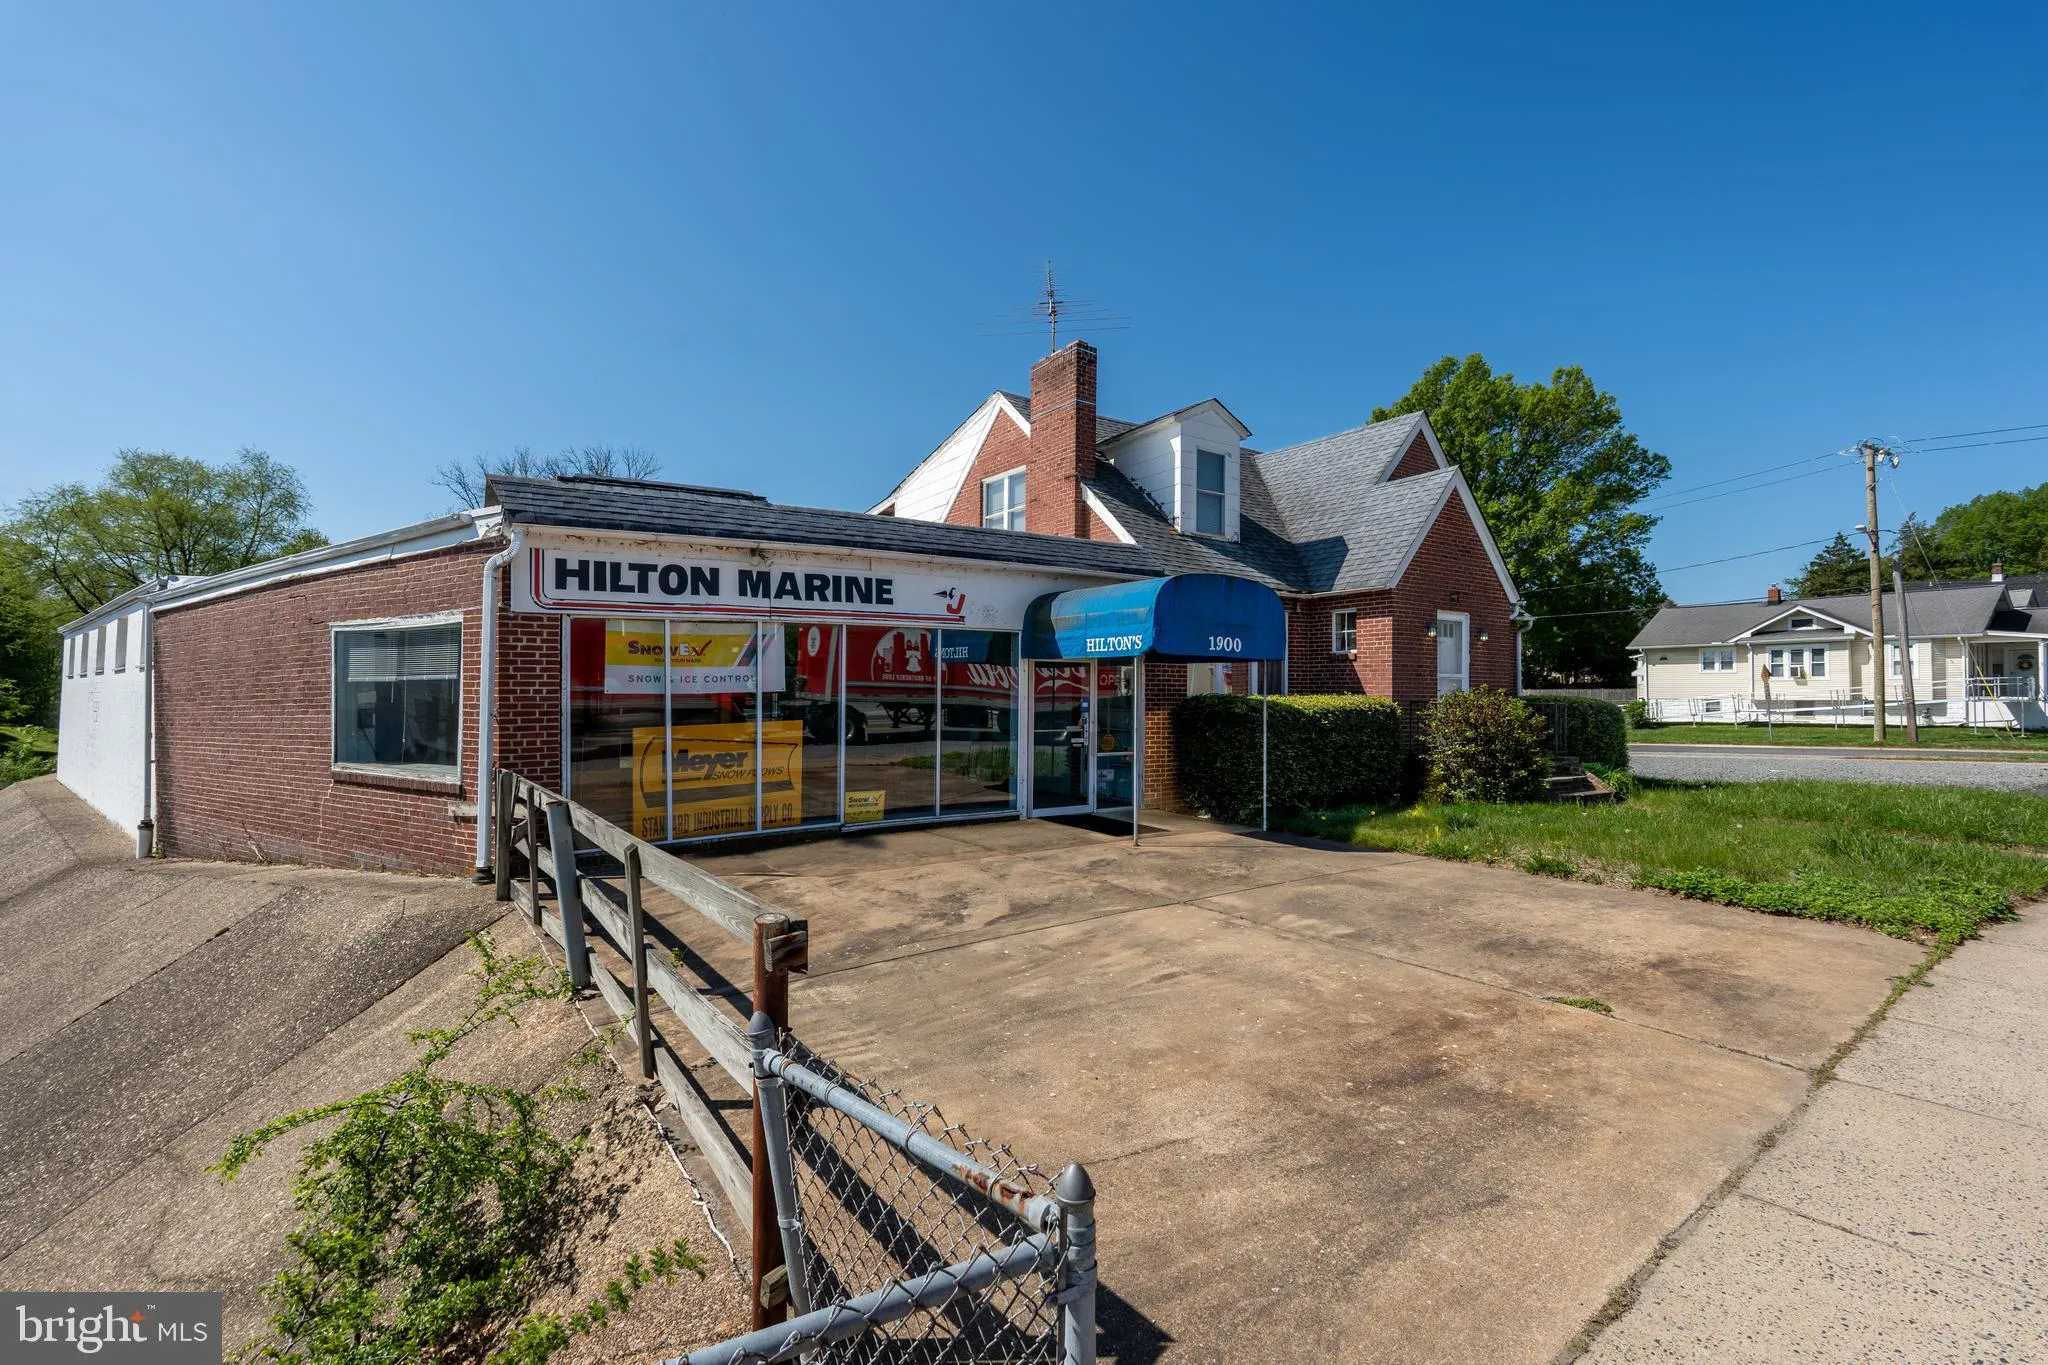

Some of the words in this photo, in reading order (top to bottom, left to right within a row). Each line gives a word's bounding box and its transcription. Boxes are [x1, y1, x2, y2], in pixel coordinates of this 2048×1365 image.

[554, 558, 720, 596] HILTON
[738, 569, 894, 605] MARINE
[1086, 635, 1143, 652] HILTON'S
[1209, 636, 1242, 653] 1900
[628, 674, 662, 683] SNOW
[680, 675, 698, 684] ICE
[703, 674, 756, 684] CONTROL
[662, 749, 748, 781] Meyer
[747, 766, 784, 777] POWS
[642, 813, 689, 838] STANARD
[693, 807, 744, 832] INDUSTRIAL
[782, 802, 795, 821] CO.
